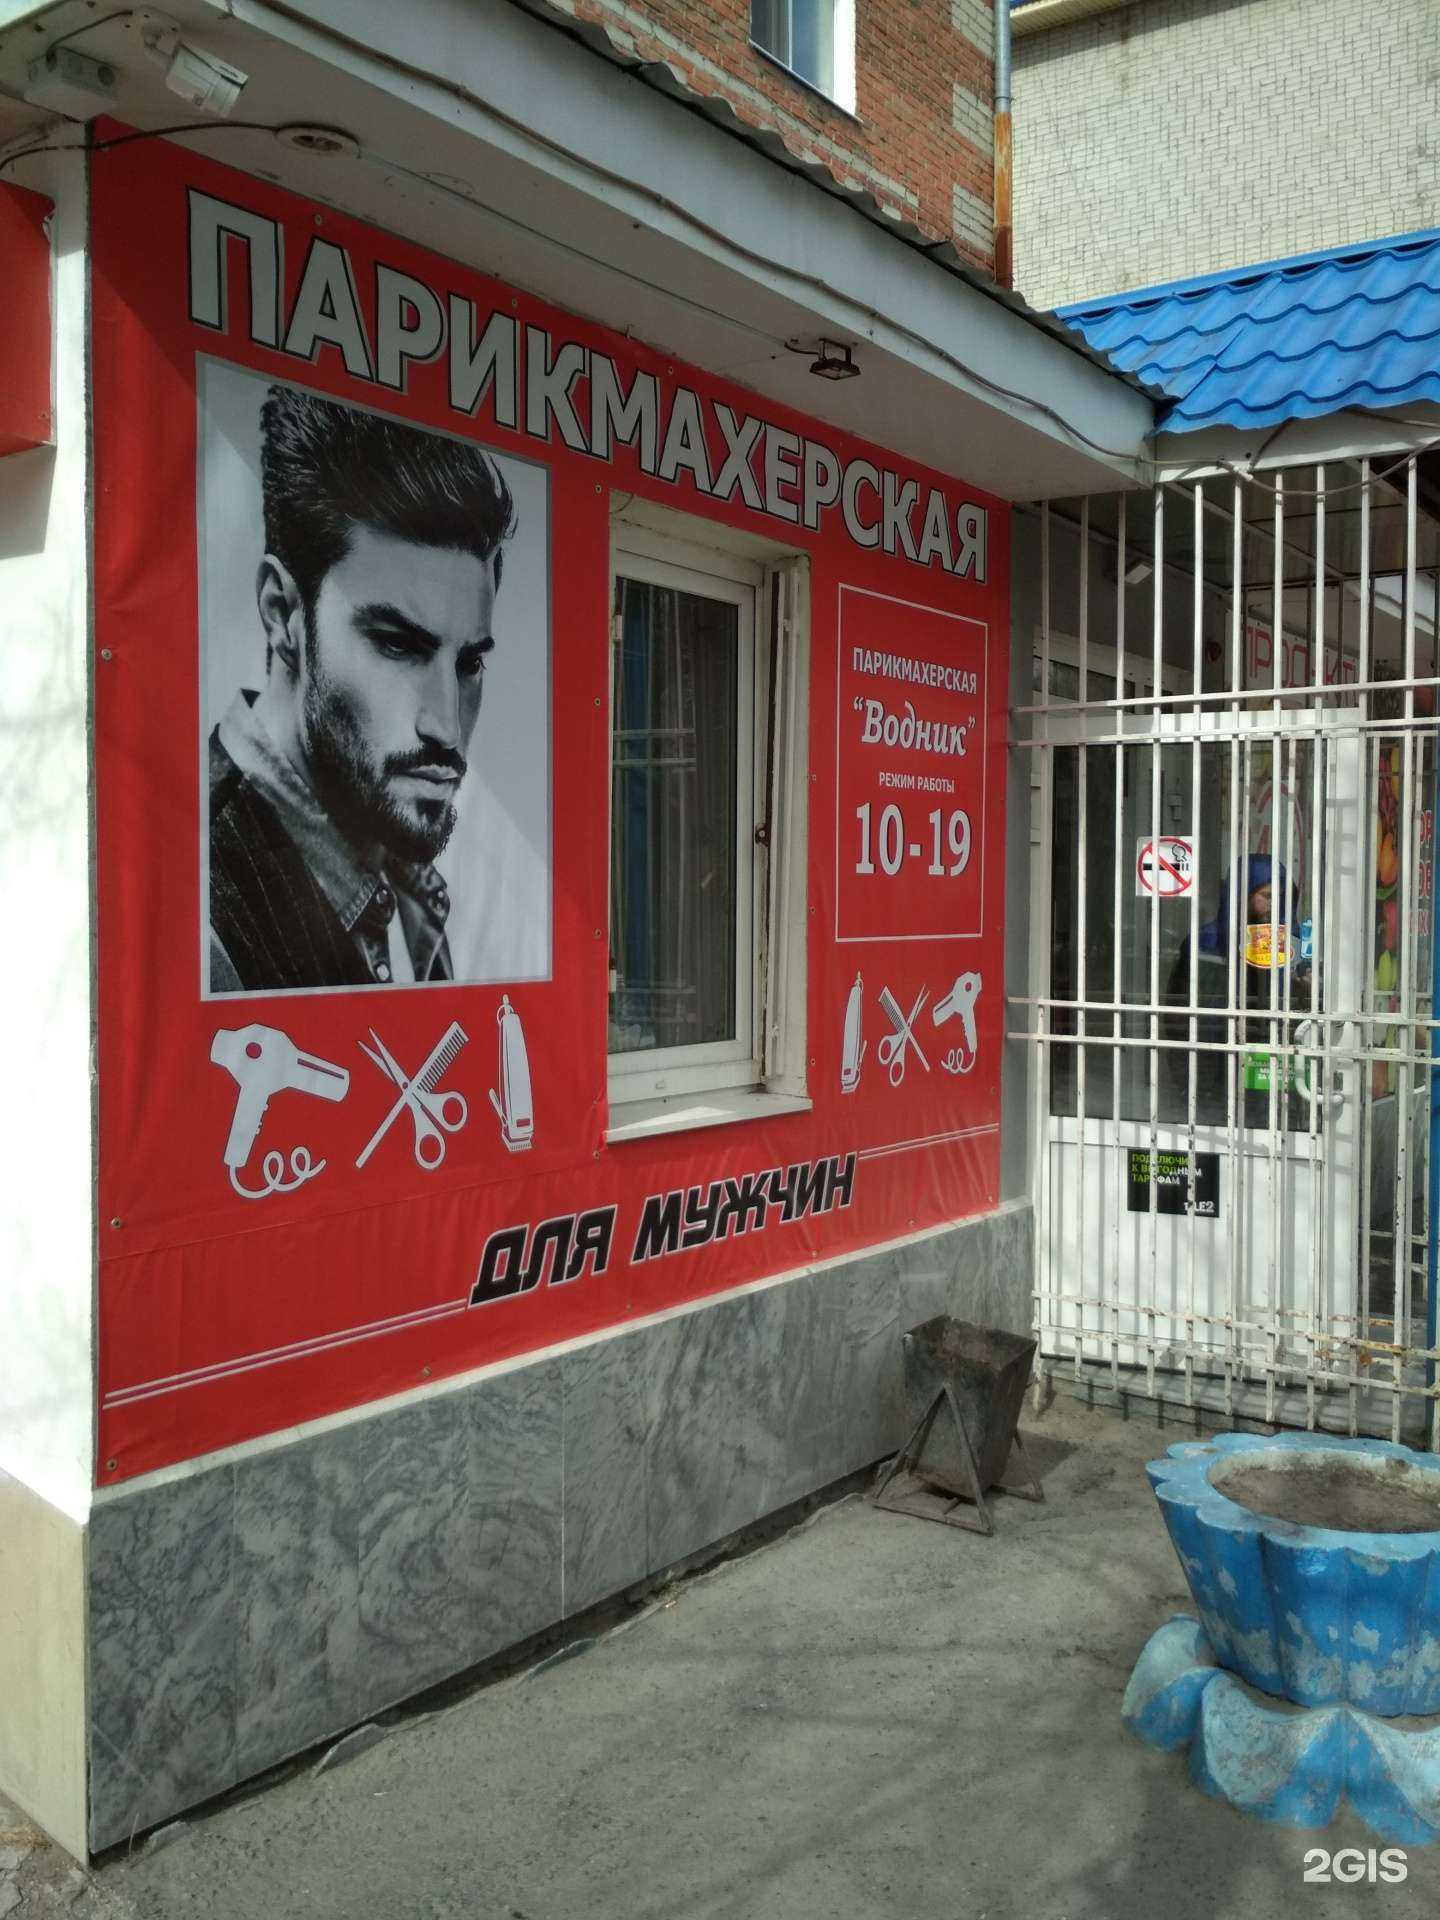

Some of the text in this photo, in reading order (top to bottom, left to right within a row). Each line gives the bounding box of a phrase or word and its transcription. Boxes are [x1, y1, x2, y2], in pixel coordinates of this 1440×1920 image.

[186, 185, 988, 583] ПАРИКМАХЕРСКАЯ
[853, 647, 977, 694] ПАРИКМАХЕРСКАЯ
[879, 771, 955, 793] РЕЖИМ РАБОТЫ
[855, 802, 972, 877] 10-19
[1131, 1153, 1191, 1165] ПОДЛЮЧИ
[1141, 1164, 1202, 1176] ВГОДНМ
[1132, 1174, 1180, 1185] ТАРФАМ
[1183, 1201, 1215, 1213] TLE2
[469, 1152, 857, 1308] ДЛЯ МУЖЧИН
